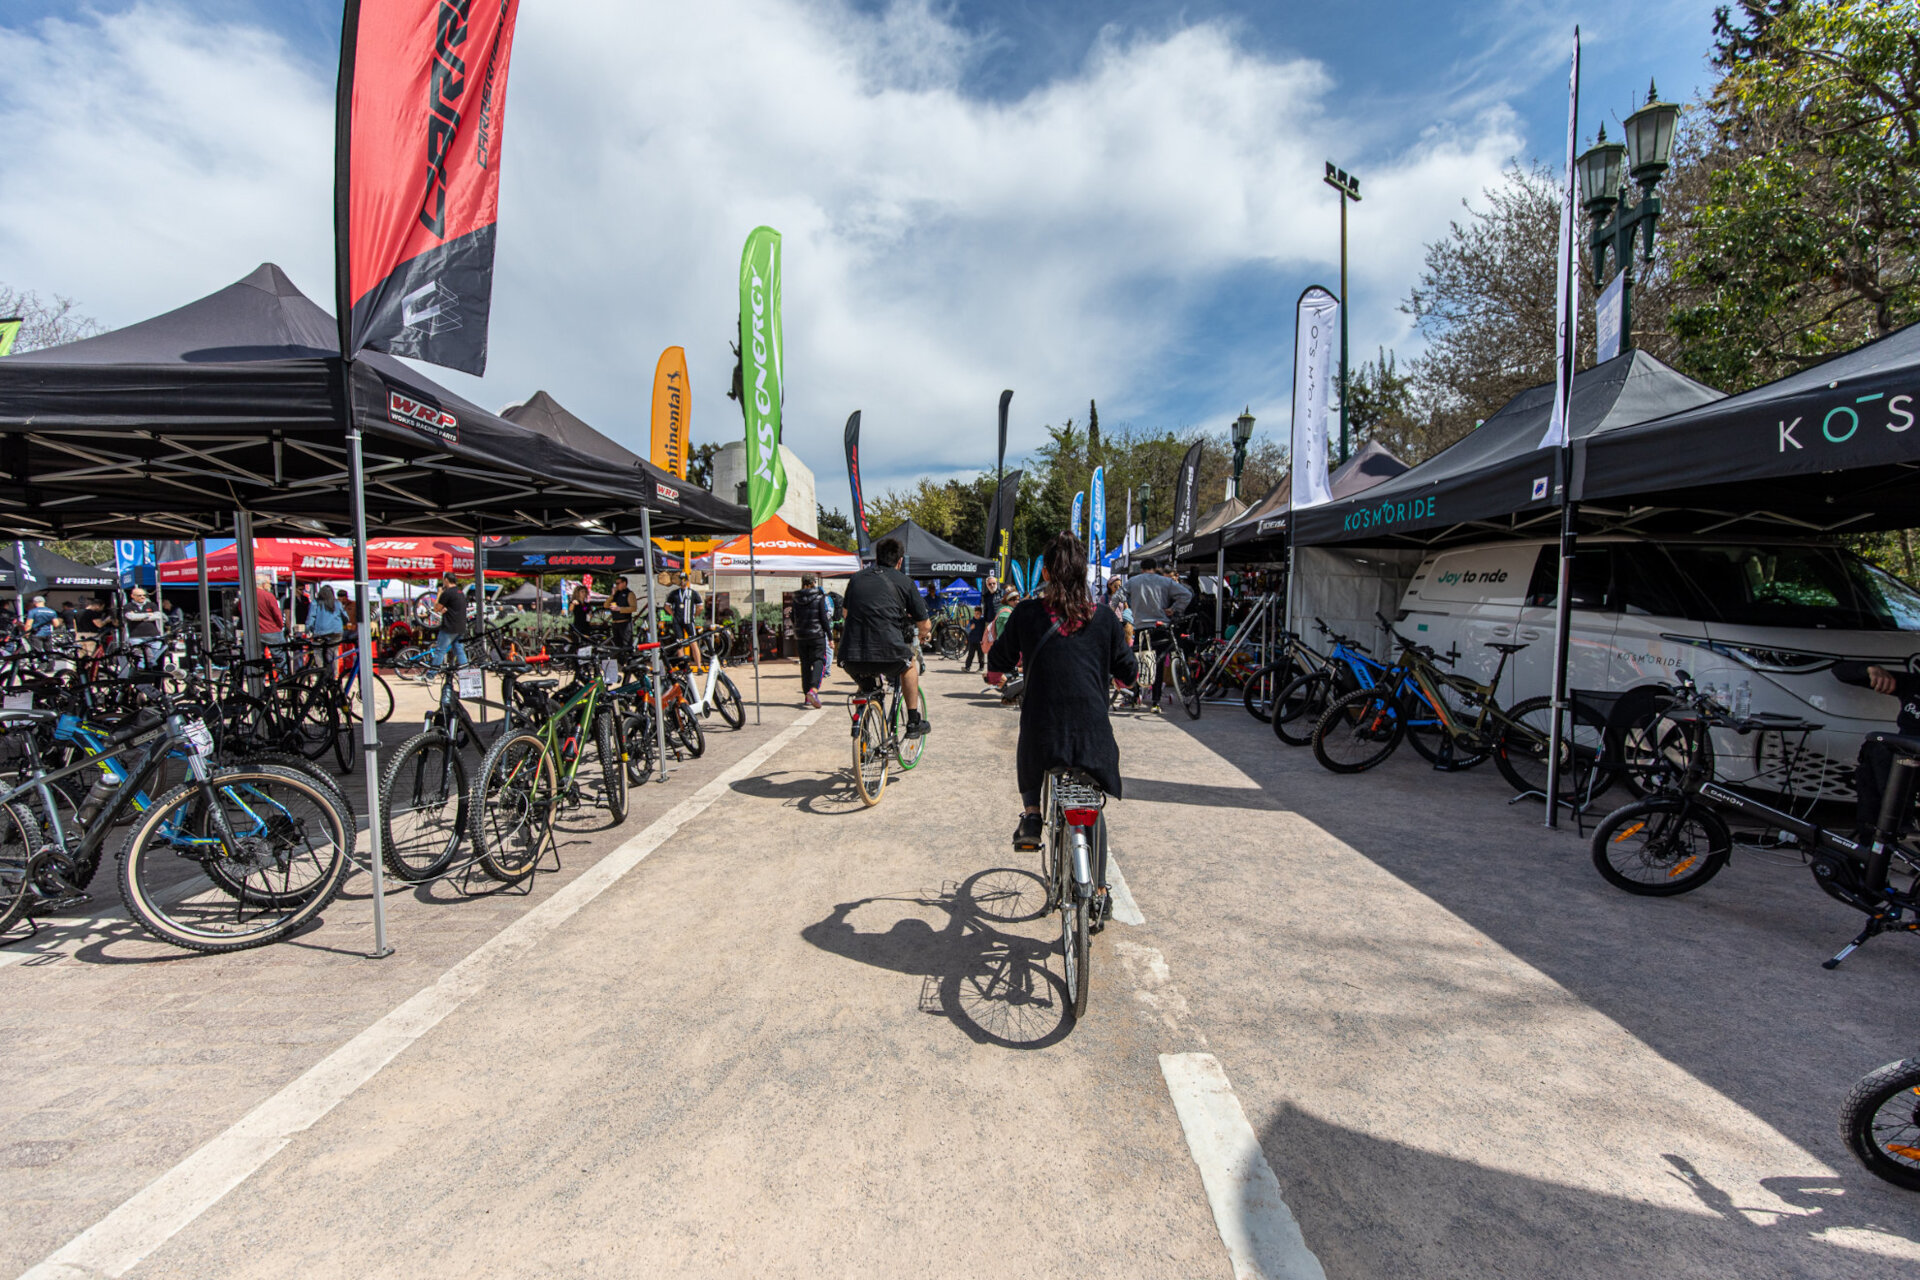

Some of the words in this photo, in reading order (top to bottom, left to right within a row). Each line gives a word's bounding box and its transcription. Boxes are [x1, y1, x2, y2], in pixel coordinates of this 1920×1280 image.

[419, 0, 472, 240] CARR
[751, 263, 771, 416] ENERGY
[390, 391, 457, 429] WRP
[391, 412, 415, 426] WORKS
[415, 421, 438, 435] RACING
[438, 429, 457, 441] PARTS
[664, 384, 681, 478] ontinental
[754, 419, 775, 483] MS
[656, 483, 679, 498] WRP
[301, 556, 352, 569] MOTUL
[386, 557, 436, 569] MOTUL
[548, 555, 616, 566] GATSOULIS
[931, 562, 978, 572] cannondale
[56, 577, 114, 585] HAIBIKE
[1438, 570, 1462, 586] Joy
[1463, 570, 1477, 583] to
[1710, 789, 1744, 807] DAHON
